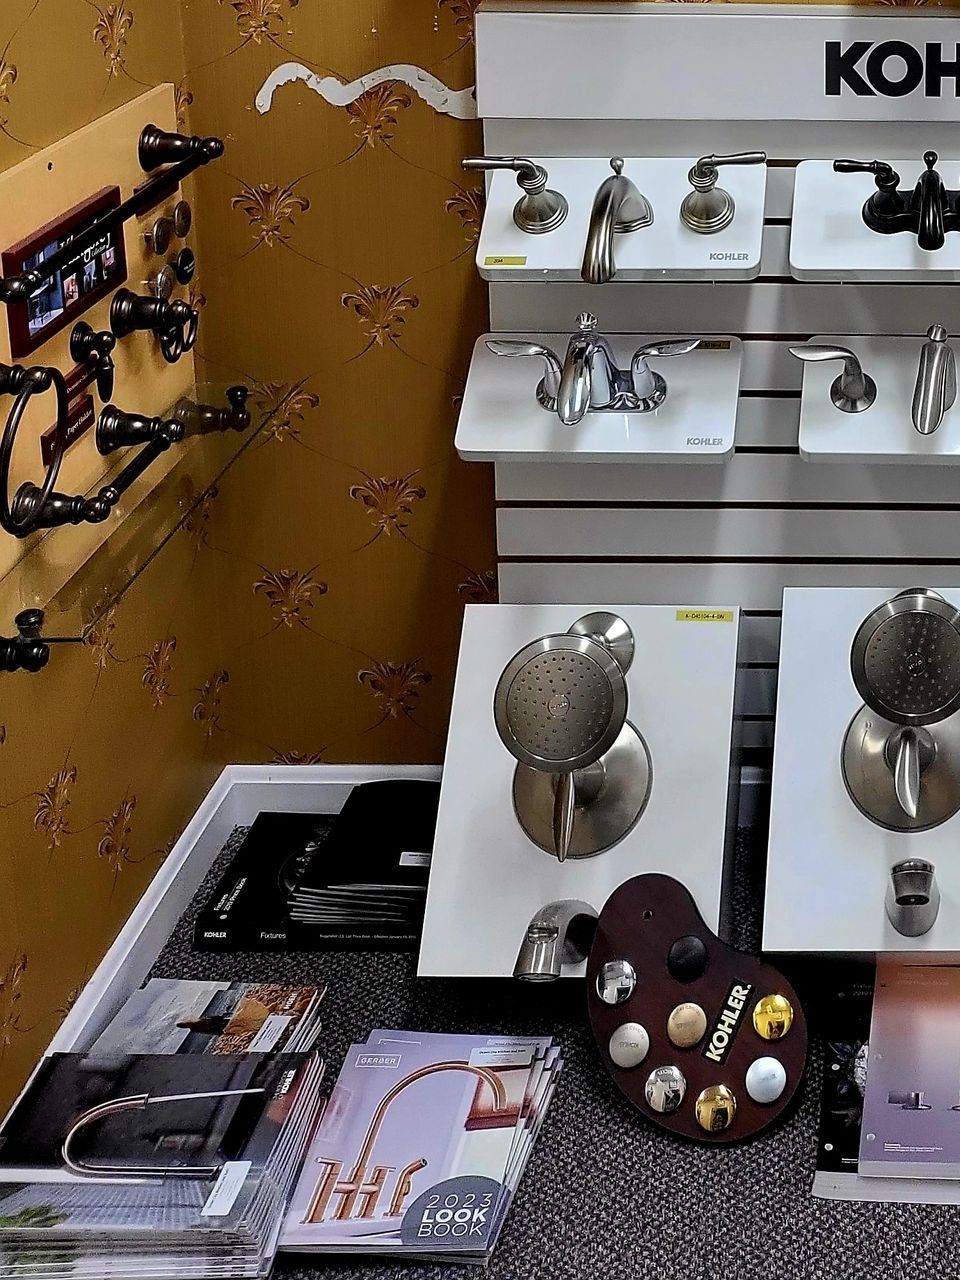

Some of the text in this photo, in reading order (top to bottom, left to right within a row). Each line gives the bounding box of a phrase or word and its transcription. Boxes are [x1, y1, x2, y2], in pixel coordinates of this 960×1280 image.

[709, 252, 749, 261] KOHLER
[686, 437, 724, 446] KOHLER
[260, 931, 286, 939] Fixtures
[360, 1056, 397, 1065] GERBER
[281, 1068, 297, 1094] KOHLER
[426, 1193, 493, 1209] 2023
[421, 1207, 489, 1223] LOOK
[417, 1222, 486, 1237] BOOK
